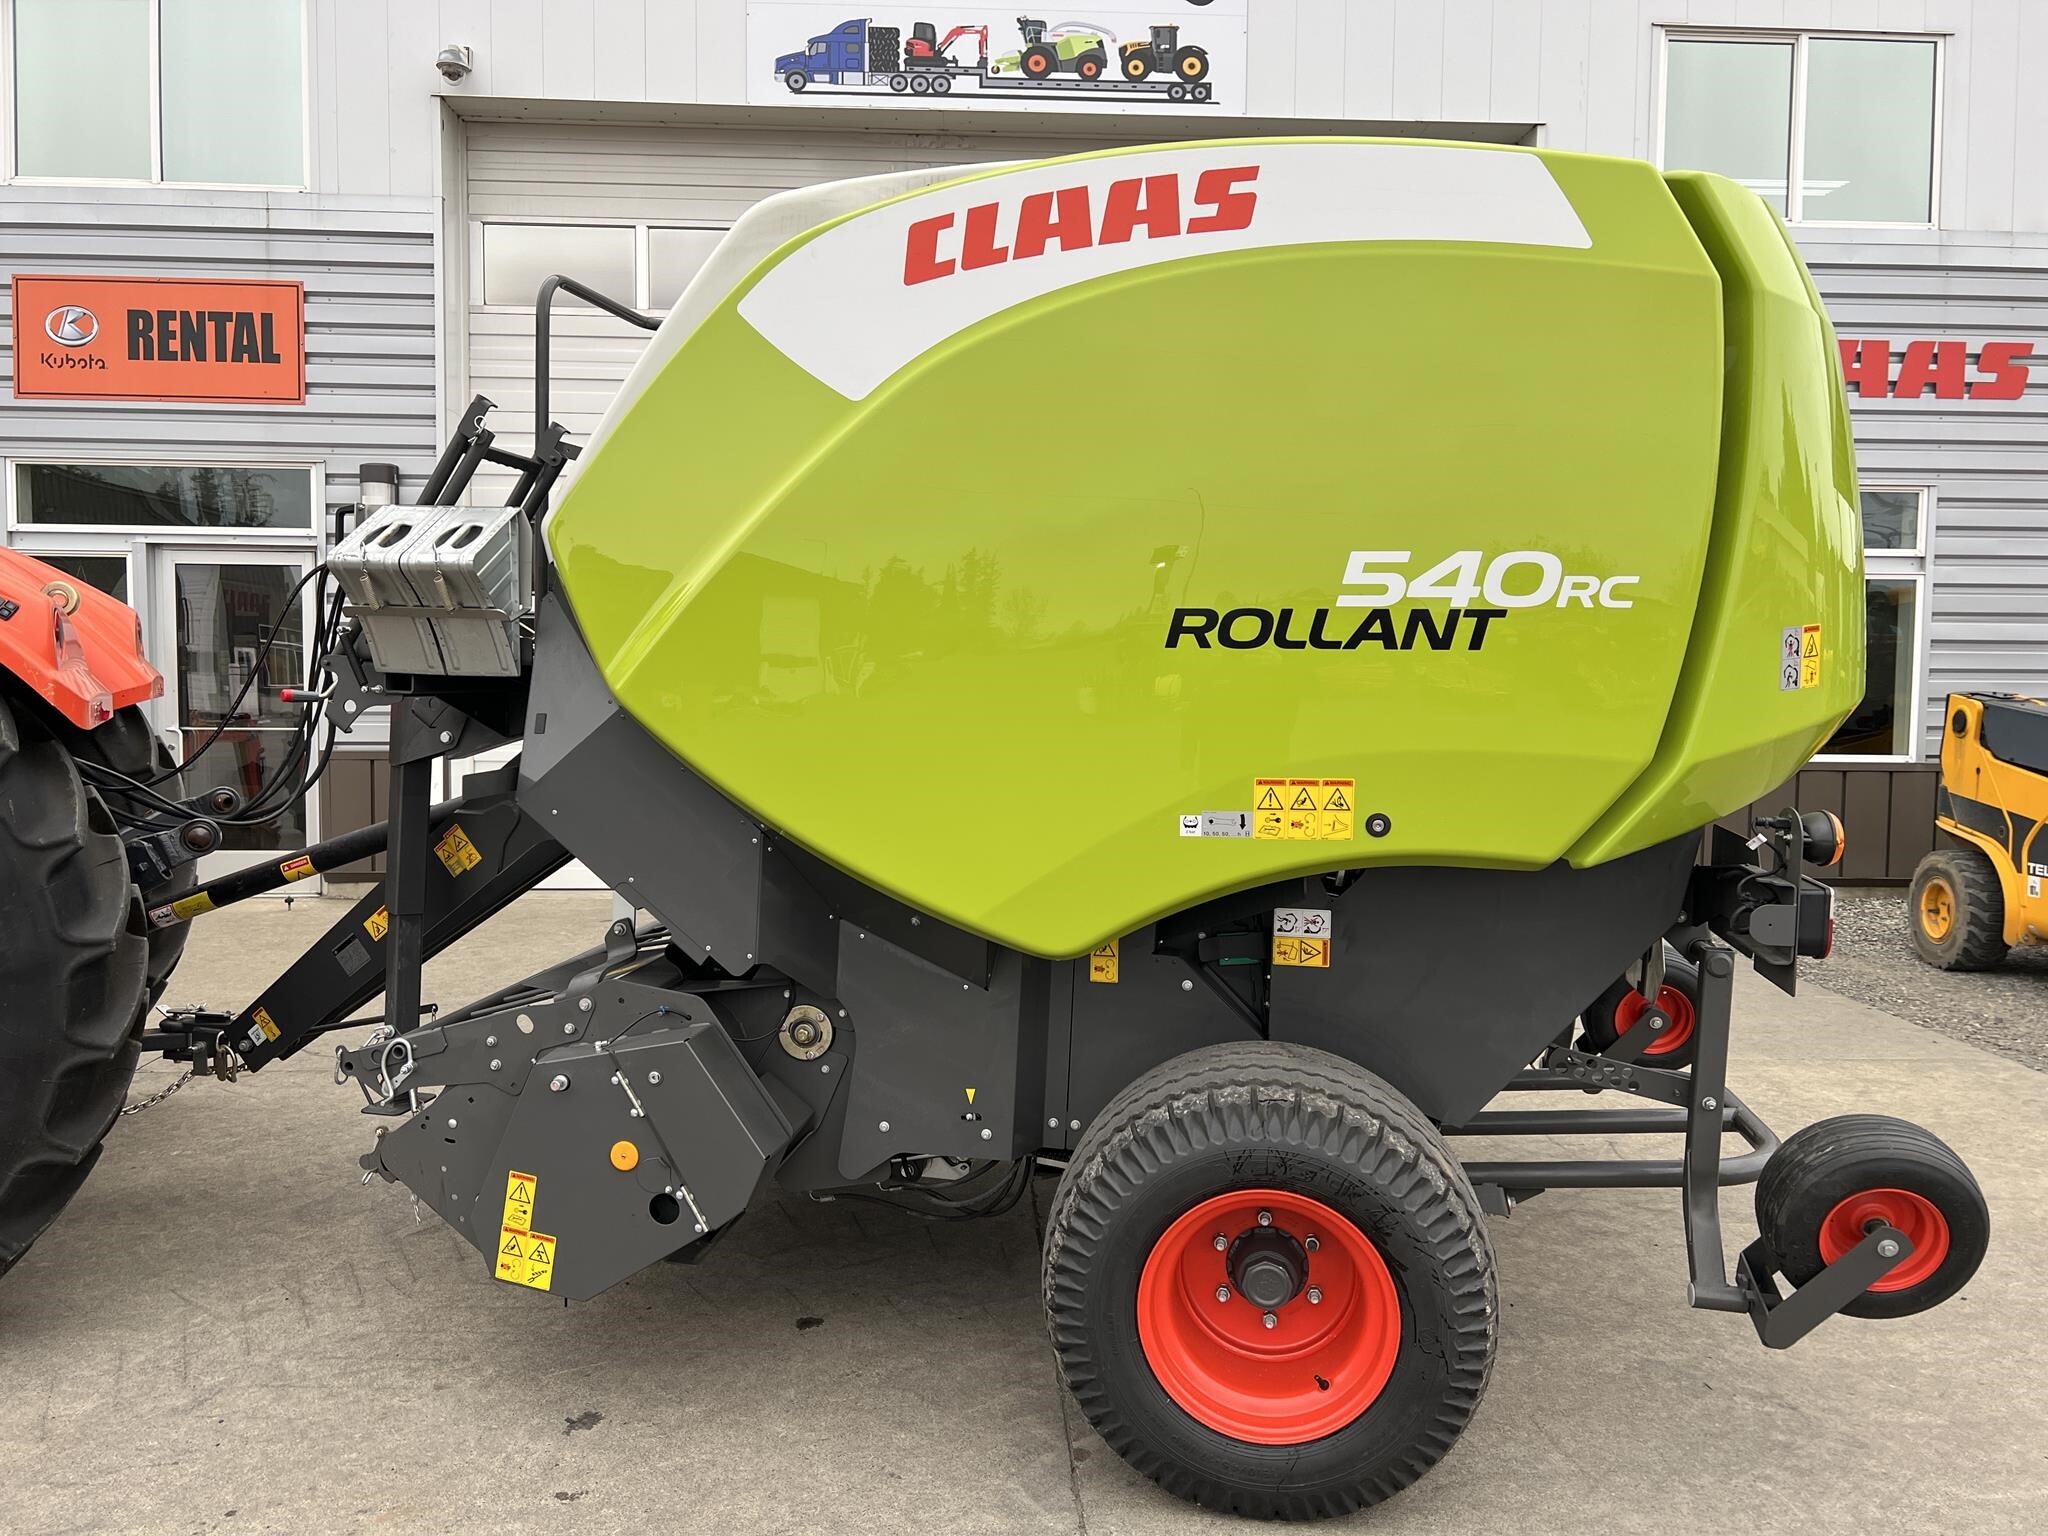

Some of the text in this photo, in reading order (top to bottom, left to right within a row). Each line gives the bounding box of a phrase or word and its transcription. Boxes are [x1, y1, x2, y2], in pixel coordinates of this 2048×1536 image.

[903, 166, 1260, 286] CLAAS
[41, 352, 106, 370] Kubota
[127, 309, 281, 364] RENTAL
[1164, 607, 1508, 651] ROLLANT
